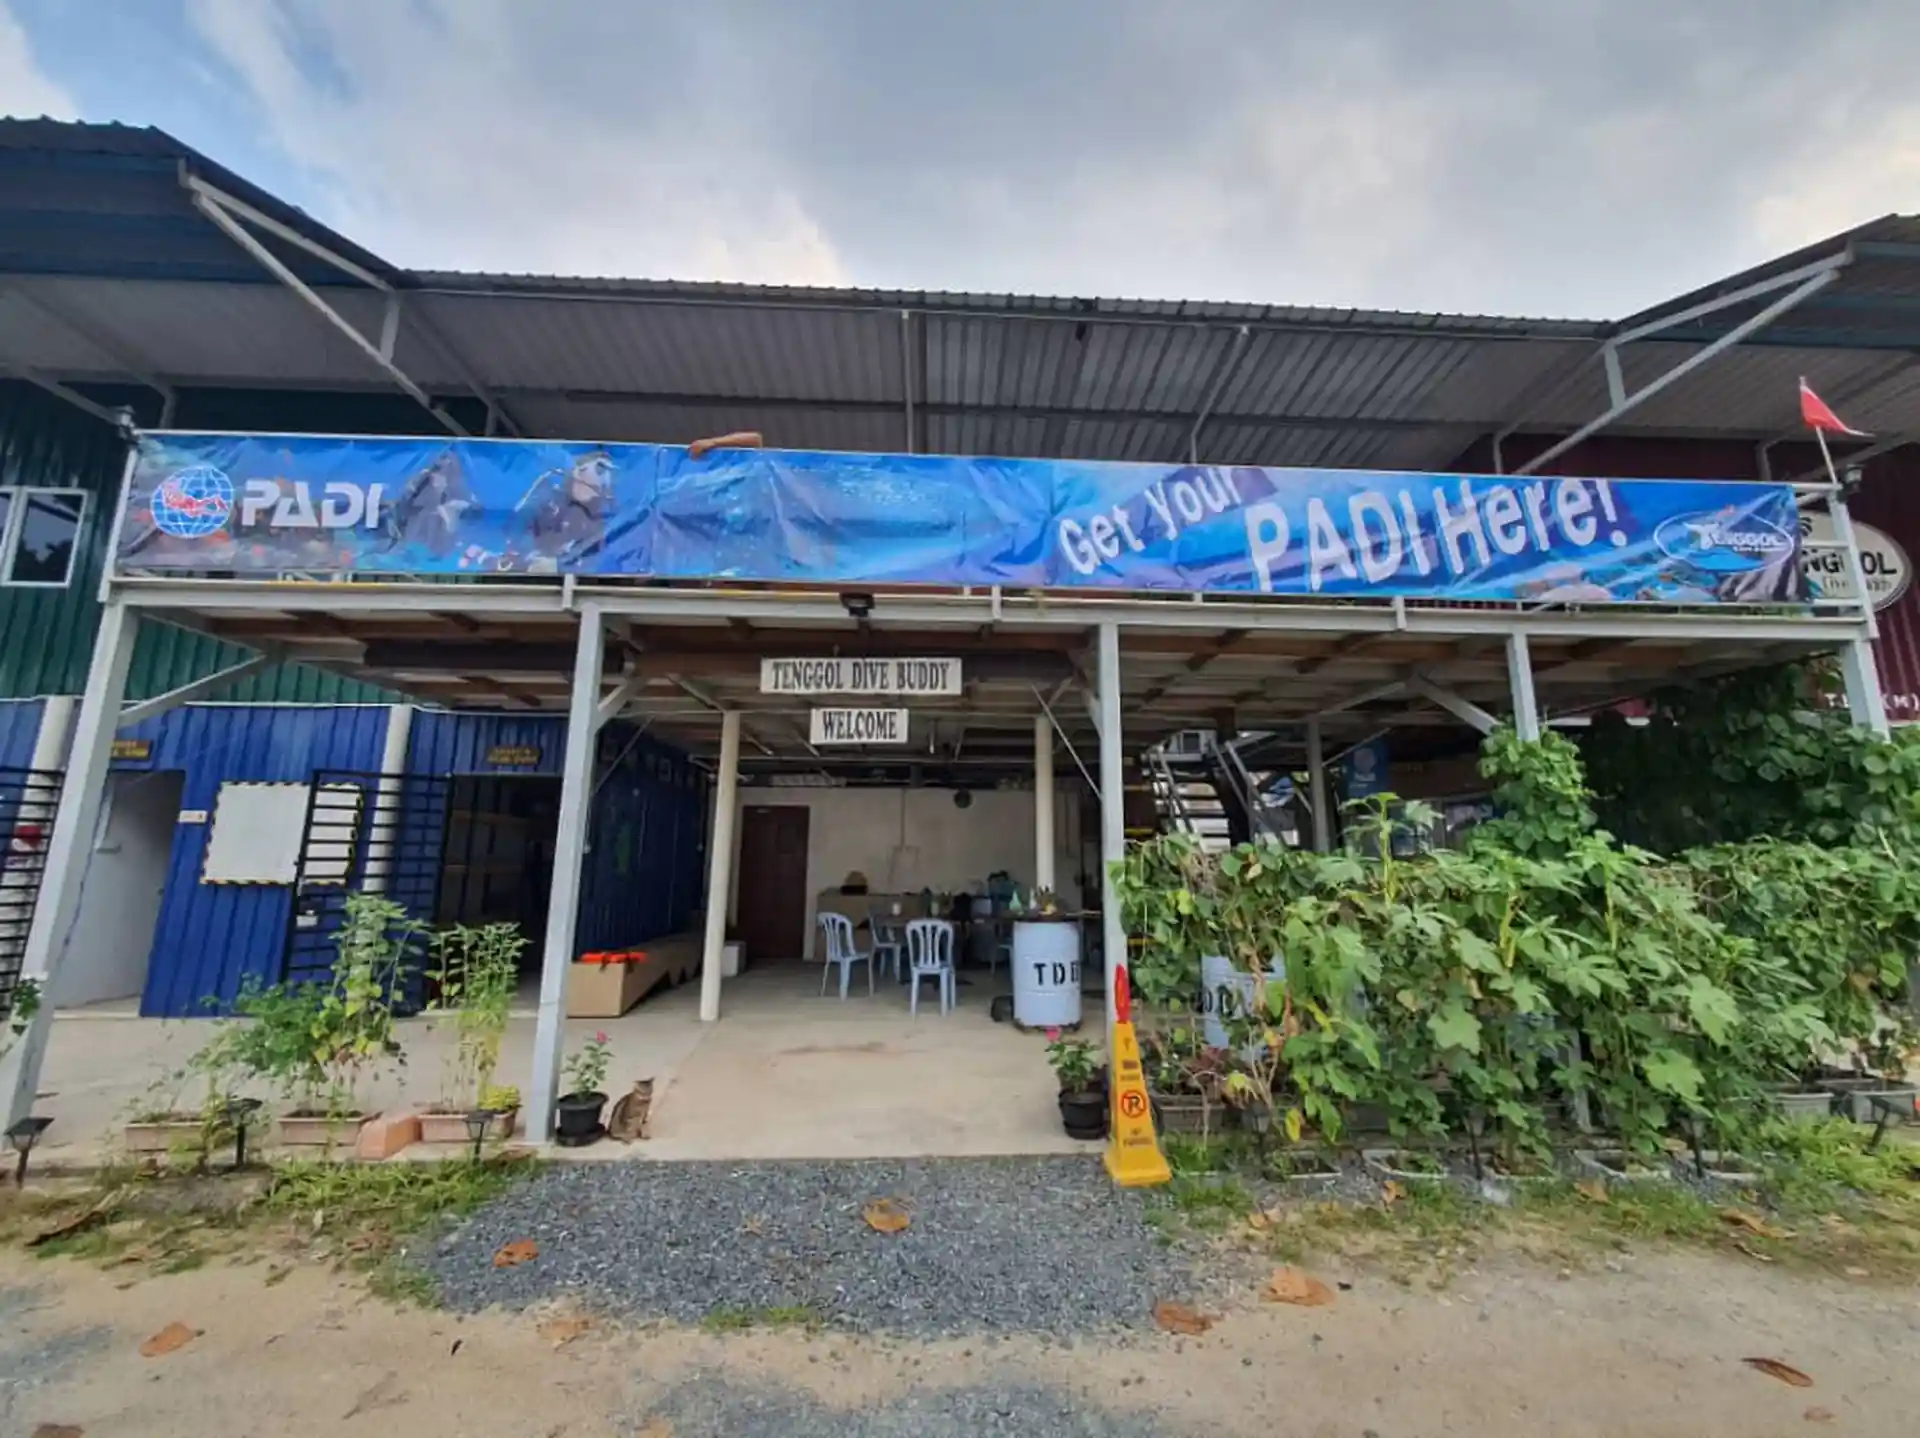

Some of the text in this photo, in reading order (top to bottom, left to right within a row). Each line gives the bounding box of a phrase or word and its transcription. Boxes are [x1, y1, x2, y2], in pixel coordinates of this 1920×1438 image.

[240, 479, 386, 529] PADI
[1060, 467, 1241, 574] Get Your
[1245, 478, 1627, 592] PADI Here!
[772, 661, 950, 690] TENGGOL DIVE BUDDY
[823, 711, 897, 740] WELCOME
